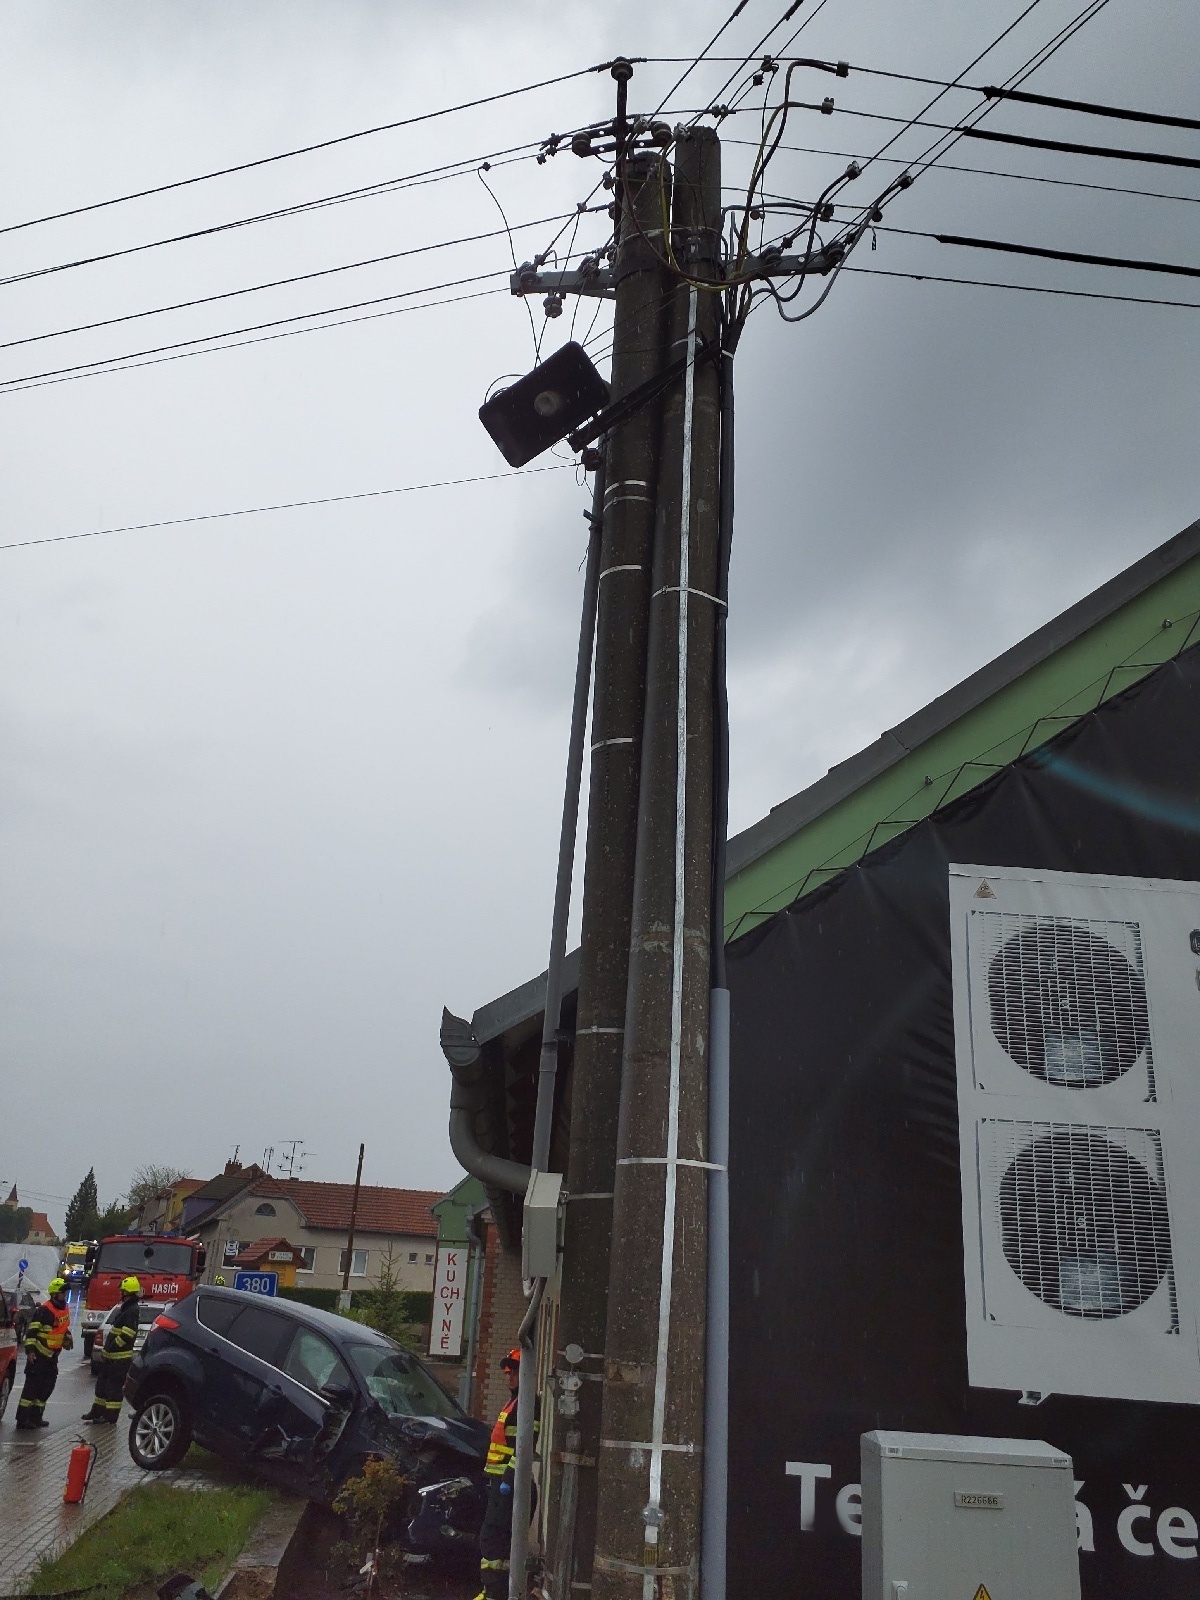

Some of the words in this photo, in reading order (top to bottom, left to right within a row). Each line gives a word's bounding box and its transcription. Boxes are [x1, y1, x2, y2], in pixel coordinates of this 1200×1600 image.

[152, 1282, 179, 1294] HASIČI
[242, 1277, 270, 1293] 380
[440, 1252, 460, 1350] KUCHYNĚ
